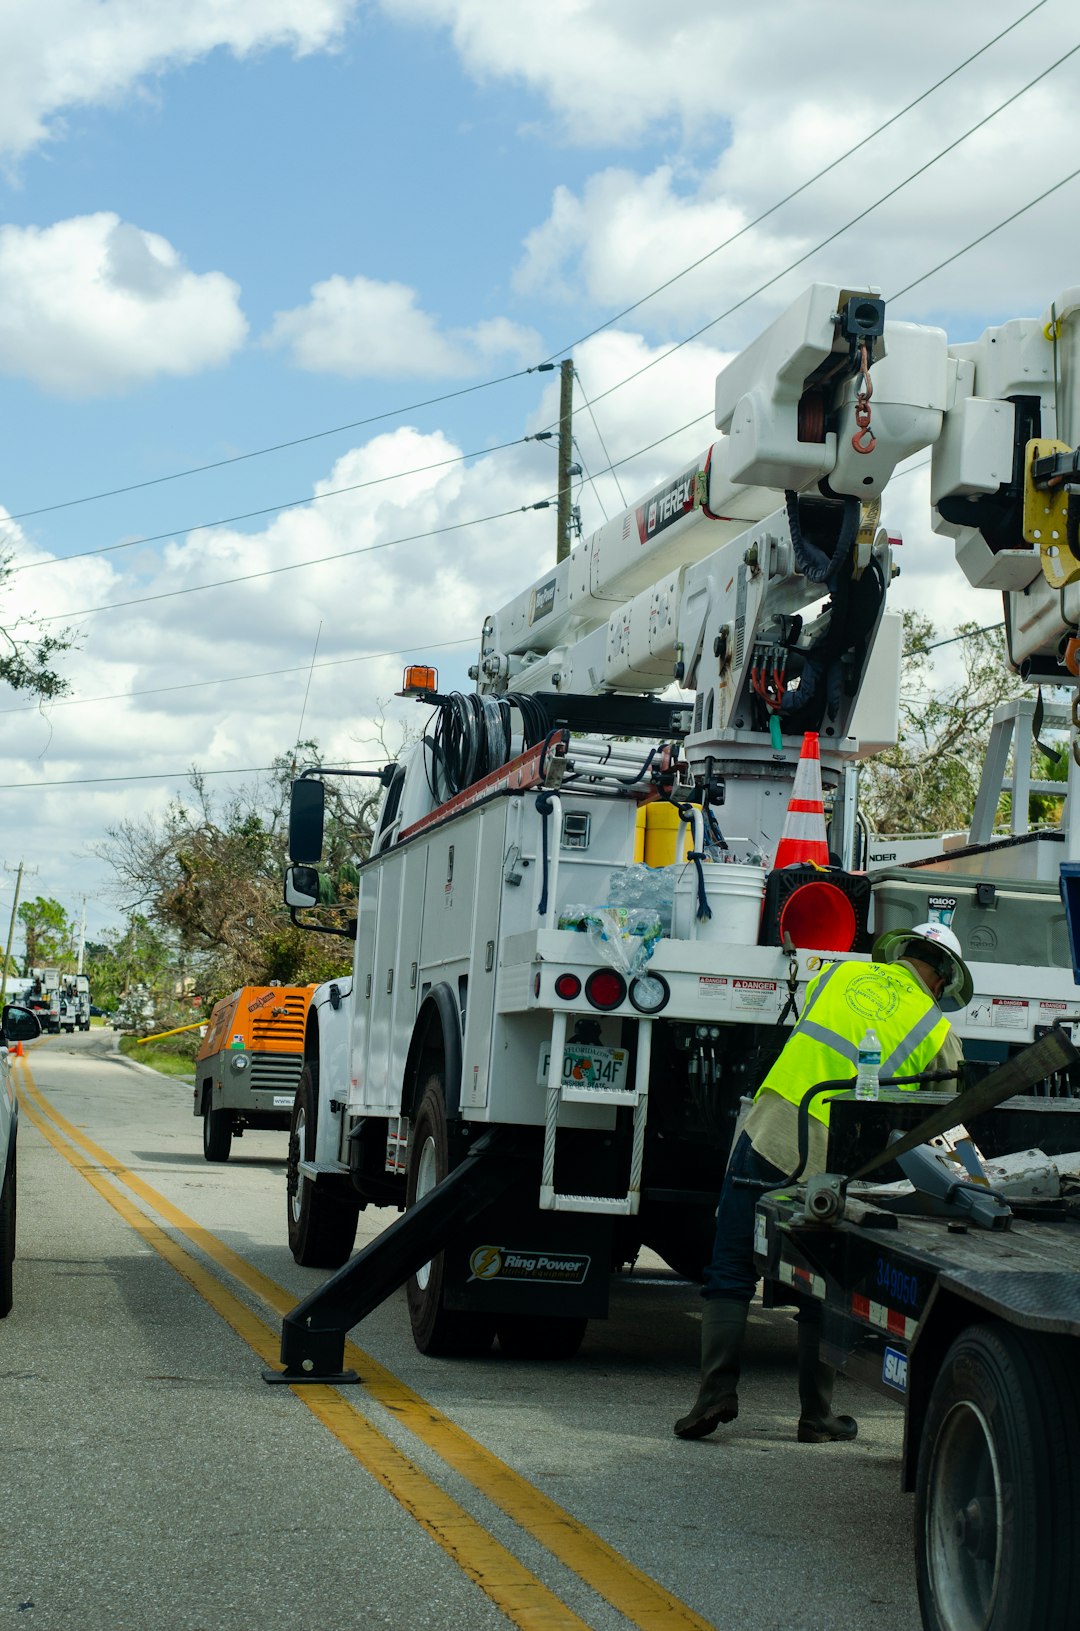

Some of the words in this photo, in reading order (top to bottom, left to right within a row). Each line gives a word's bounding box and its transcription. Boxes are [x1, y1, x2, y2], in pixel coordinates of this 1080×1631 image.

[659, 479, 691, 523] TEREX
[929, 897, 956, 906] IGLOO
[742, 981, 775, 990] DANGER
[504, 1256, 536, 1271] Ring
[537, 1257, 581, 1272] Power
[531, 1270, 579, 1280] Equipment
[876, 1258, 918, 1305] 349050
